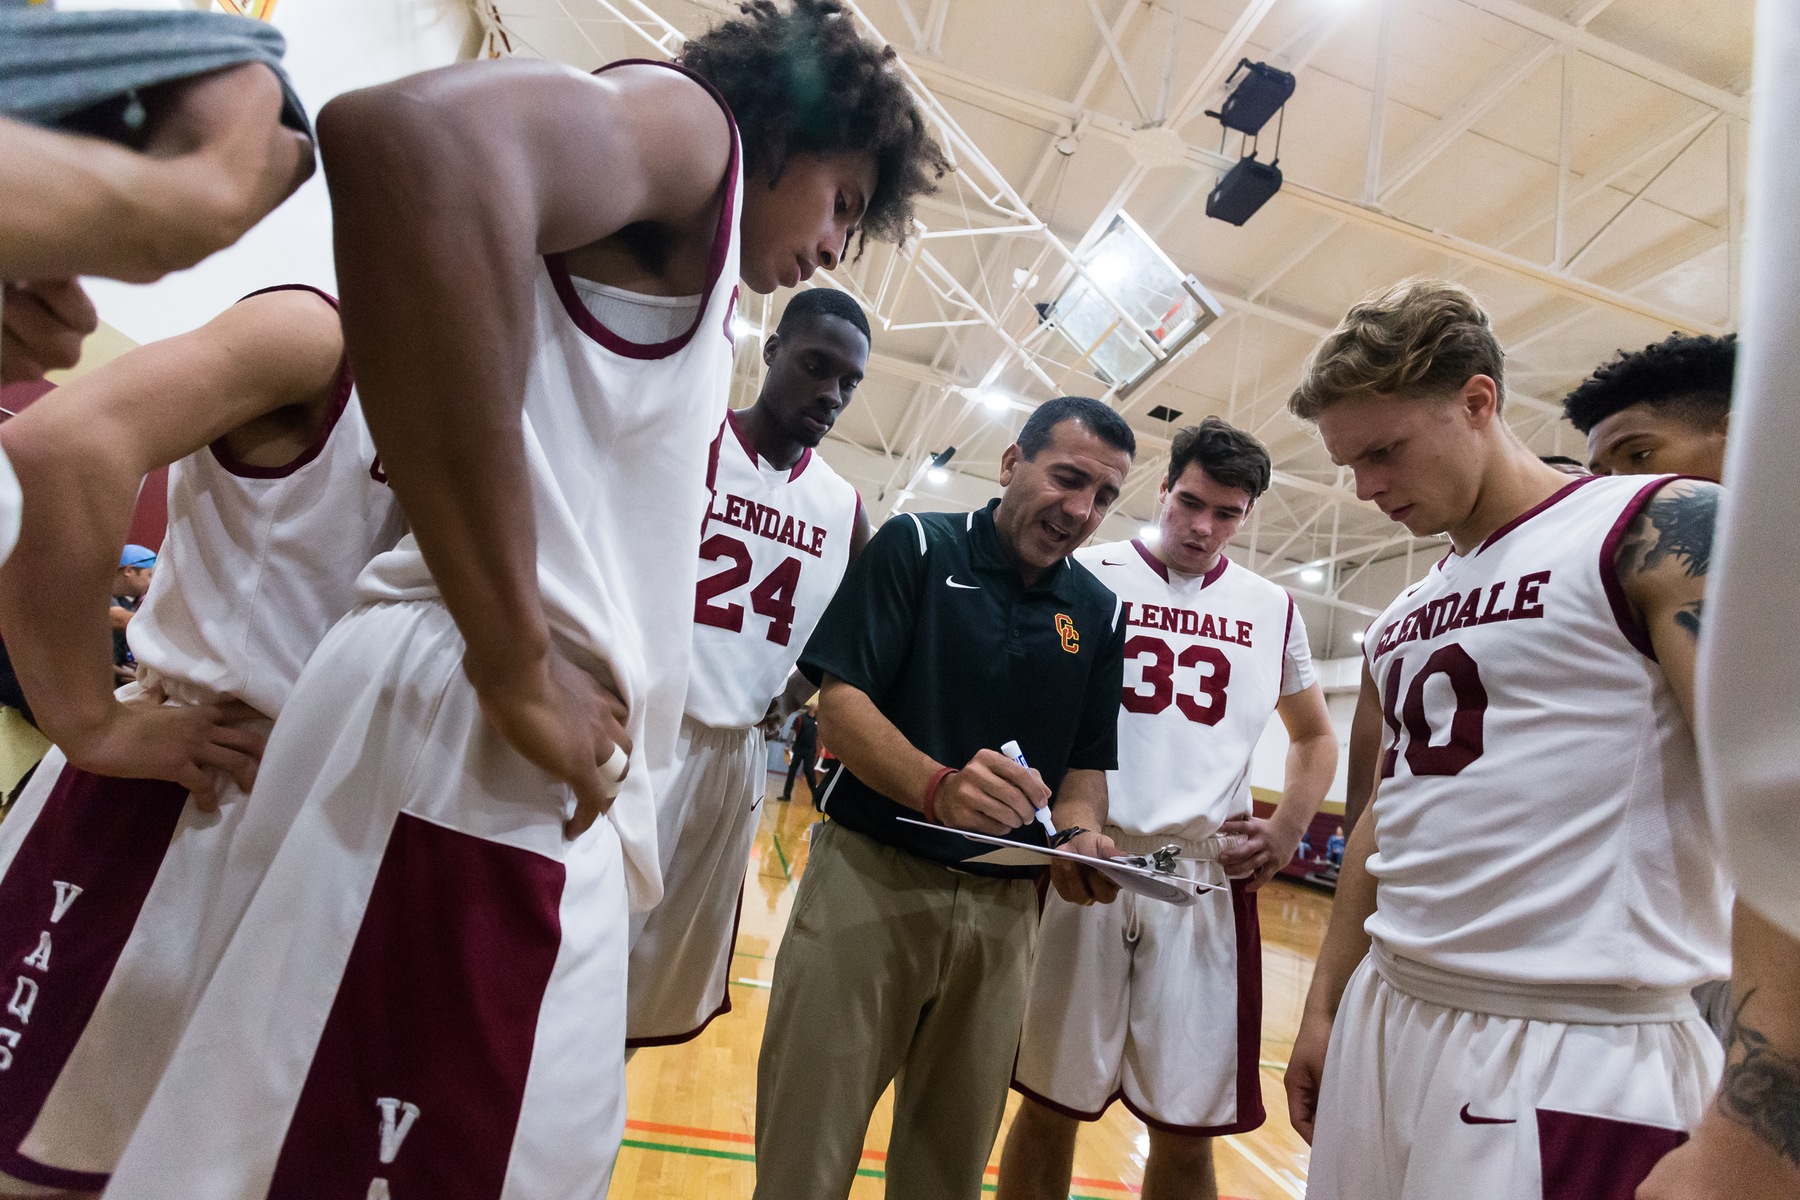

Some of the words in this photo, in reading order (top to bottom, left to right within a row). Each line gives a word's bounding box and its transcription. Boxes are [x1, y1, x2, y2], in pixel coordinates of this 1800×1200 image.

[694, 533, 802, 647] 24
[1121, 635, 1231, 727] 33
[1381, 643, 1488, 779] 10
